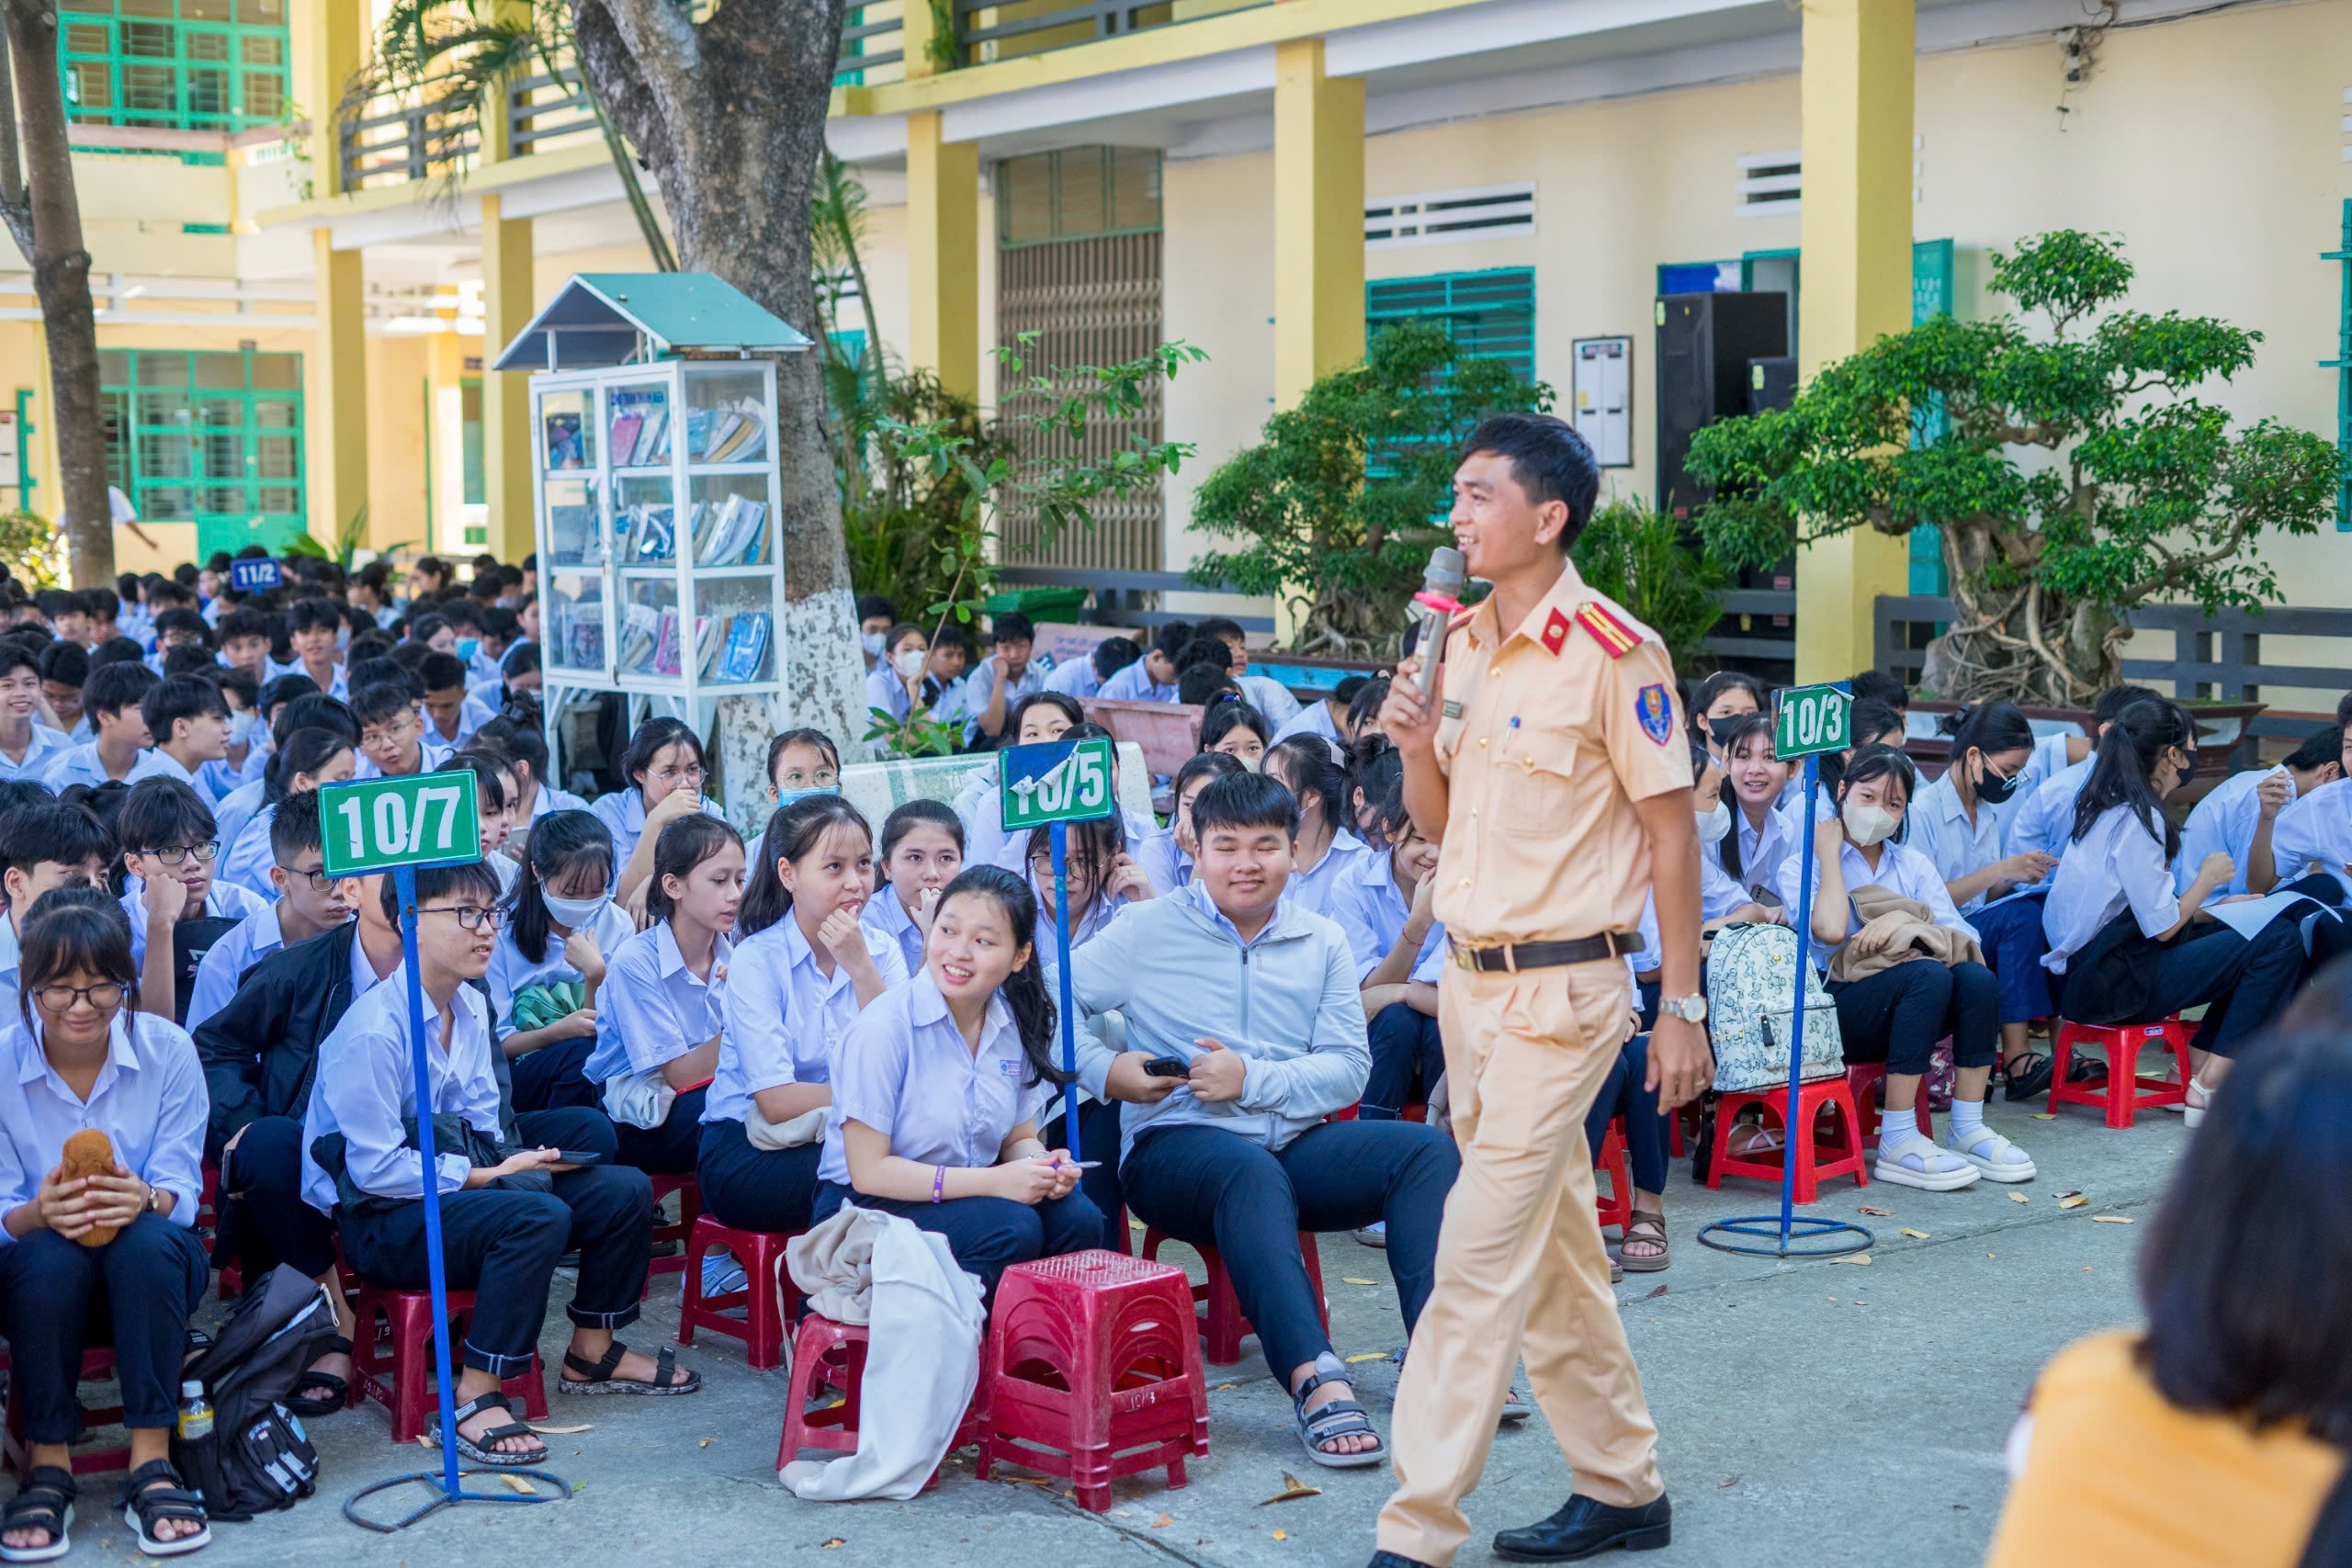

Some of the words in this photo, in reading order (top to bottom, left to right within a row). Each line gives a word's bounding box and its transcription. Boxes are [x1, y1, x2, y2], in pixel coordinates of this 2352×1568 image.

[238, 563, 276, 585] 11/2
[1782, 694, 1843, 748] 10/3
[338, 786, 460, 859] 10/7
